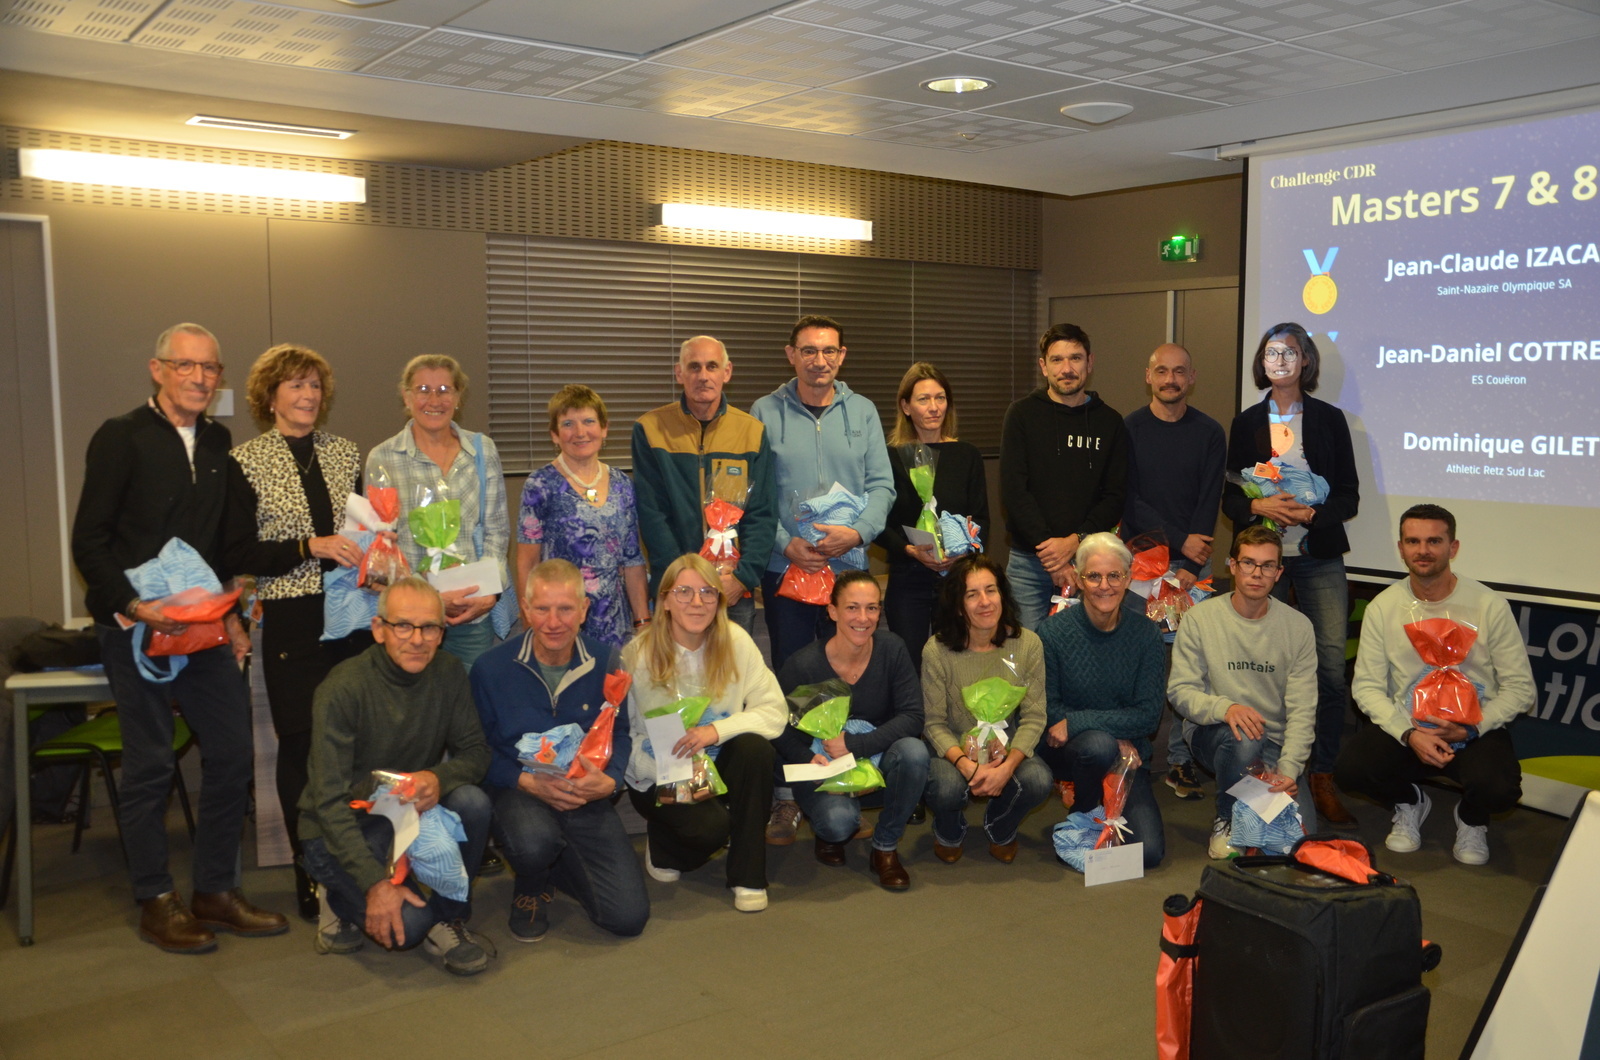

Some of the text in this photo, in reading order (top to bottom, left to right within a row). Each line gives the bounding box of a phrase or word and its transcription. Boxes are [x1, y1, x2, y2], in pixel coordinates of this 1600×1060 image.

[1270, 163, 1377, 189] Challenge CDR
[1331, 165, 1598, 226] Masters 7 & 8
[1384, 243, 1600, 282] Jean-Claude IZACA
[1437, 278, 1572, 296] Saint-Nazaire Olympique SA
[1376, 340, 1600, 369] Jean-Daniel COTTRE
[1471, 374, 1527, 385] ES Couëron
[1403, 432, 1600, 459] Dominique GILET
[1446, 464, 1546, 478] Athletic Retz Sud Lac
[1227, 660, 1276, 673] nantais
